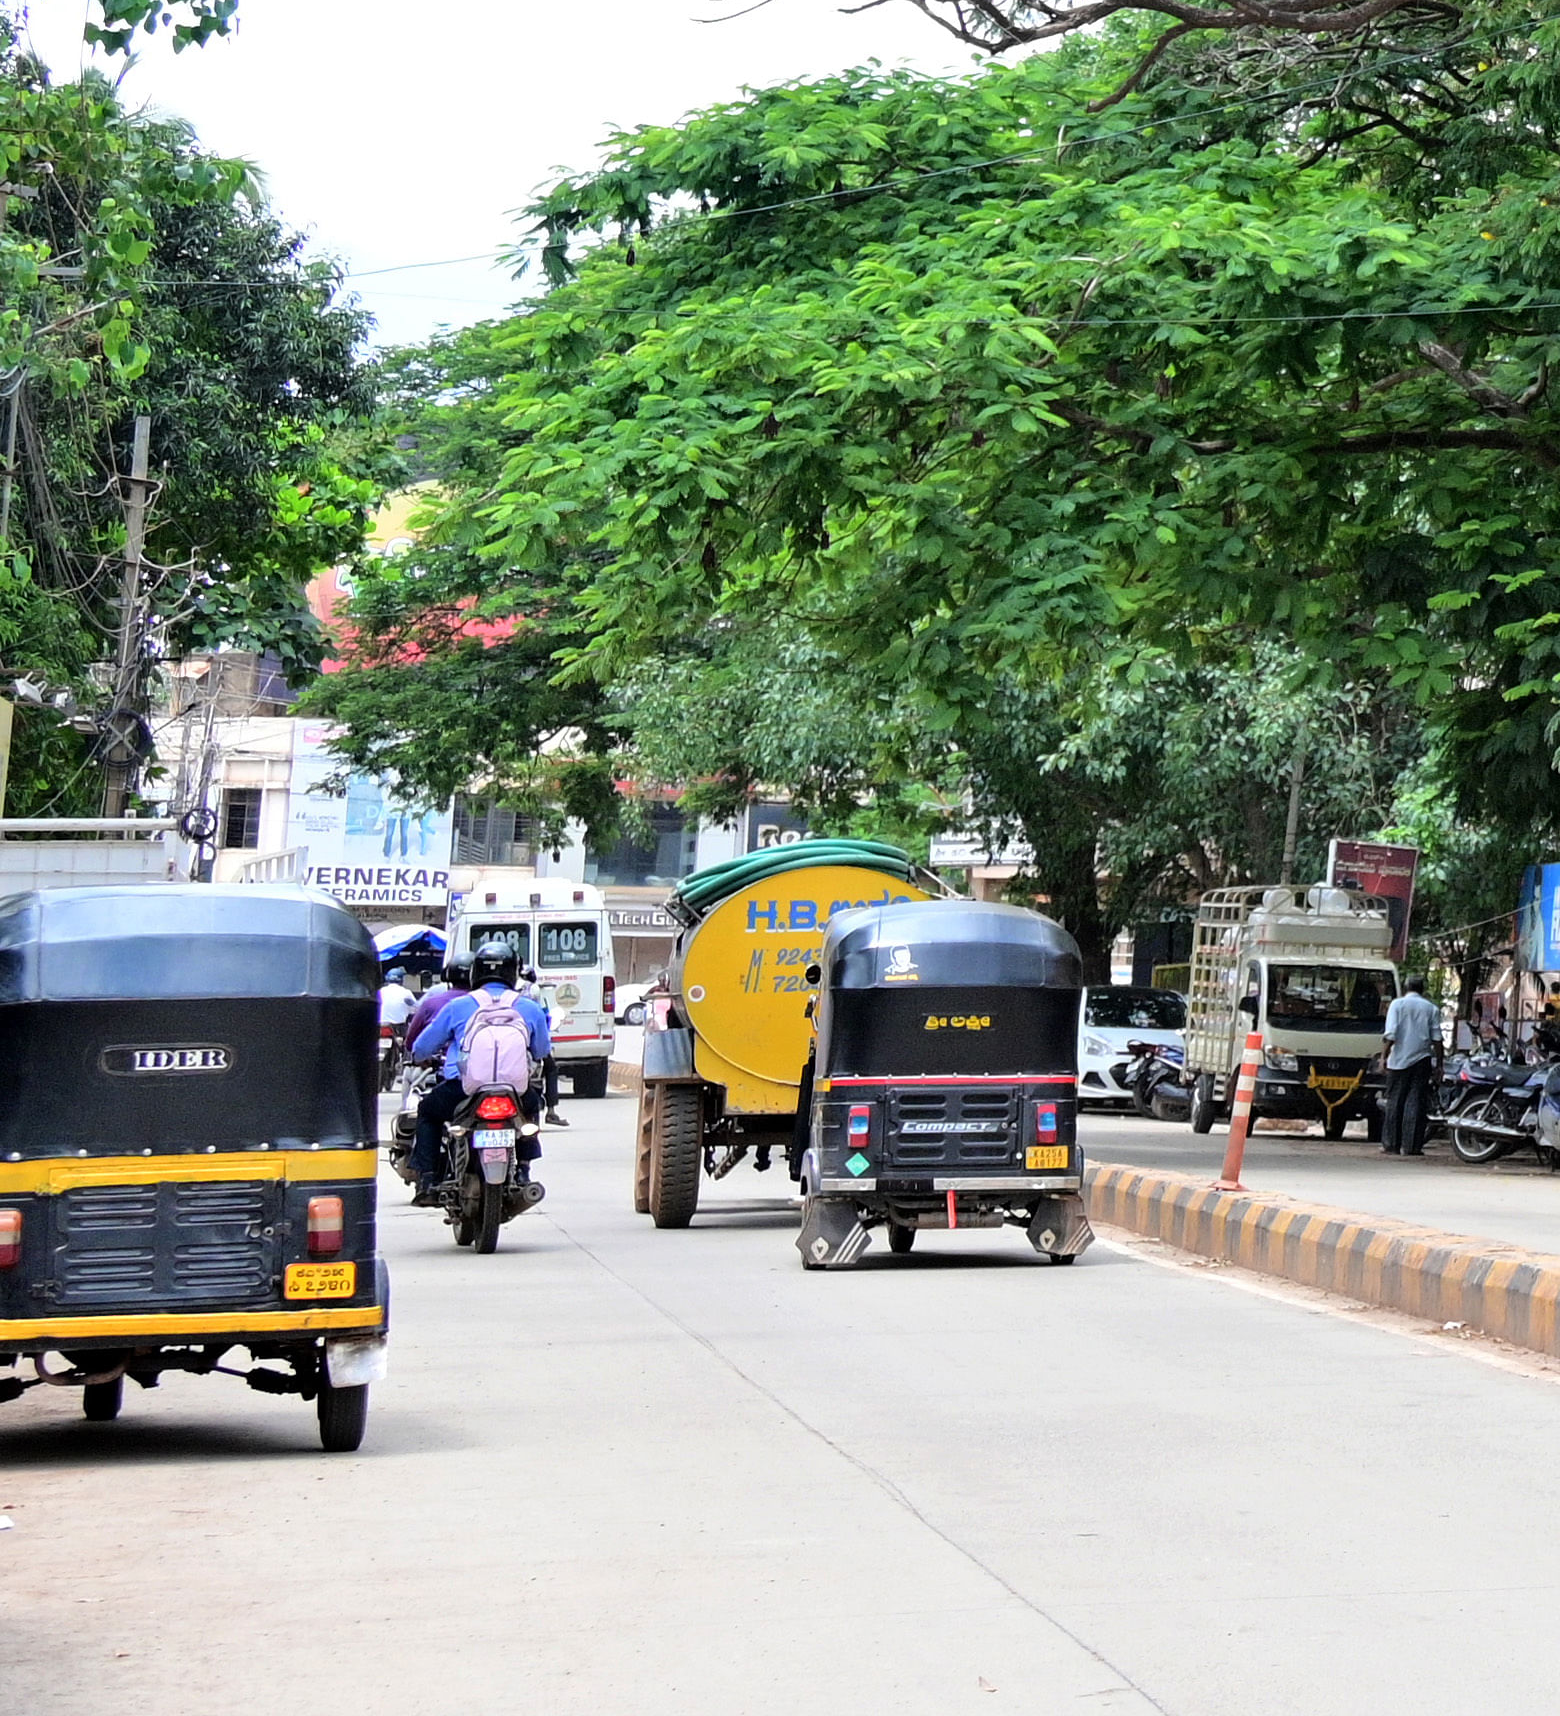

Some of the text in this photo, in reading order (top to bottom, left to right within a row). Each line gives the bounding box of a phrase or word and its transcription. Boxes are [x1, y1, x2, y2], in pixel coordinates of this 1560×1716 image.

[304, 866, 449, 889] VERNEKAR
[547, 928, 586, 951] 108
[134, 1049, 228, 1071] IDER
